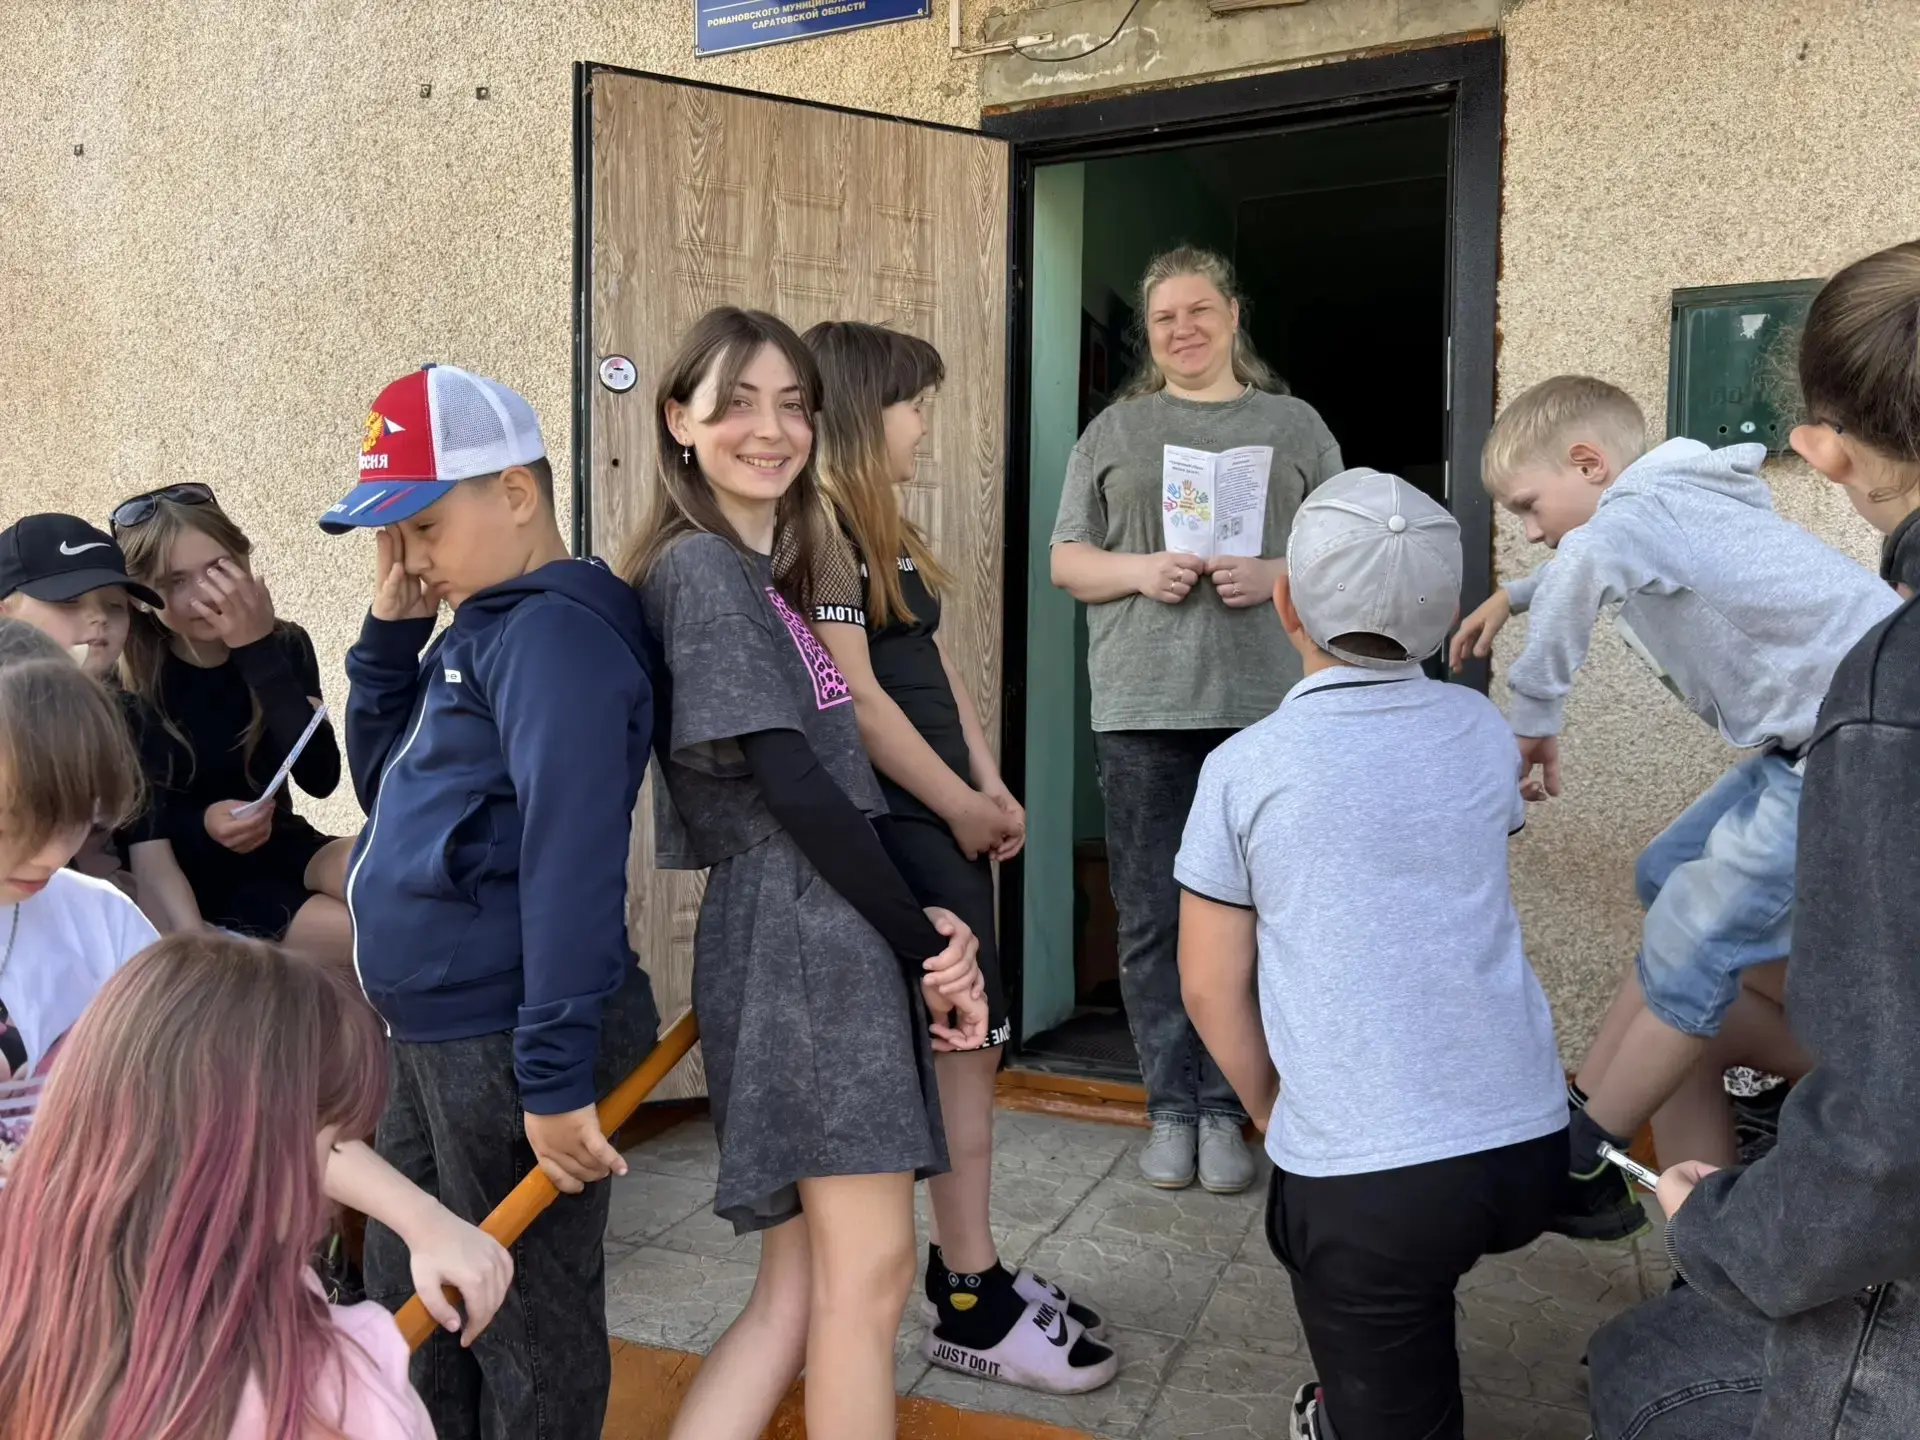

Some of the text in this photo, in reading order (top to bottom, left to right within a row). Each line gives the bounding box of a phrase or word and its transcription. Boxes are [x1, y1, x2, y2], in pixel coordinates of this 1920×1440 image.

[707, 7, 780, 27] РОМАНОВСКОГО
[752, 2, 867, 30] САРАТОВСКОЙ ОБЛАСТИ
[933, 1343, 968, 1366] JUST
[969, 1354, 988, 1372] DO
